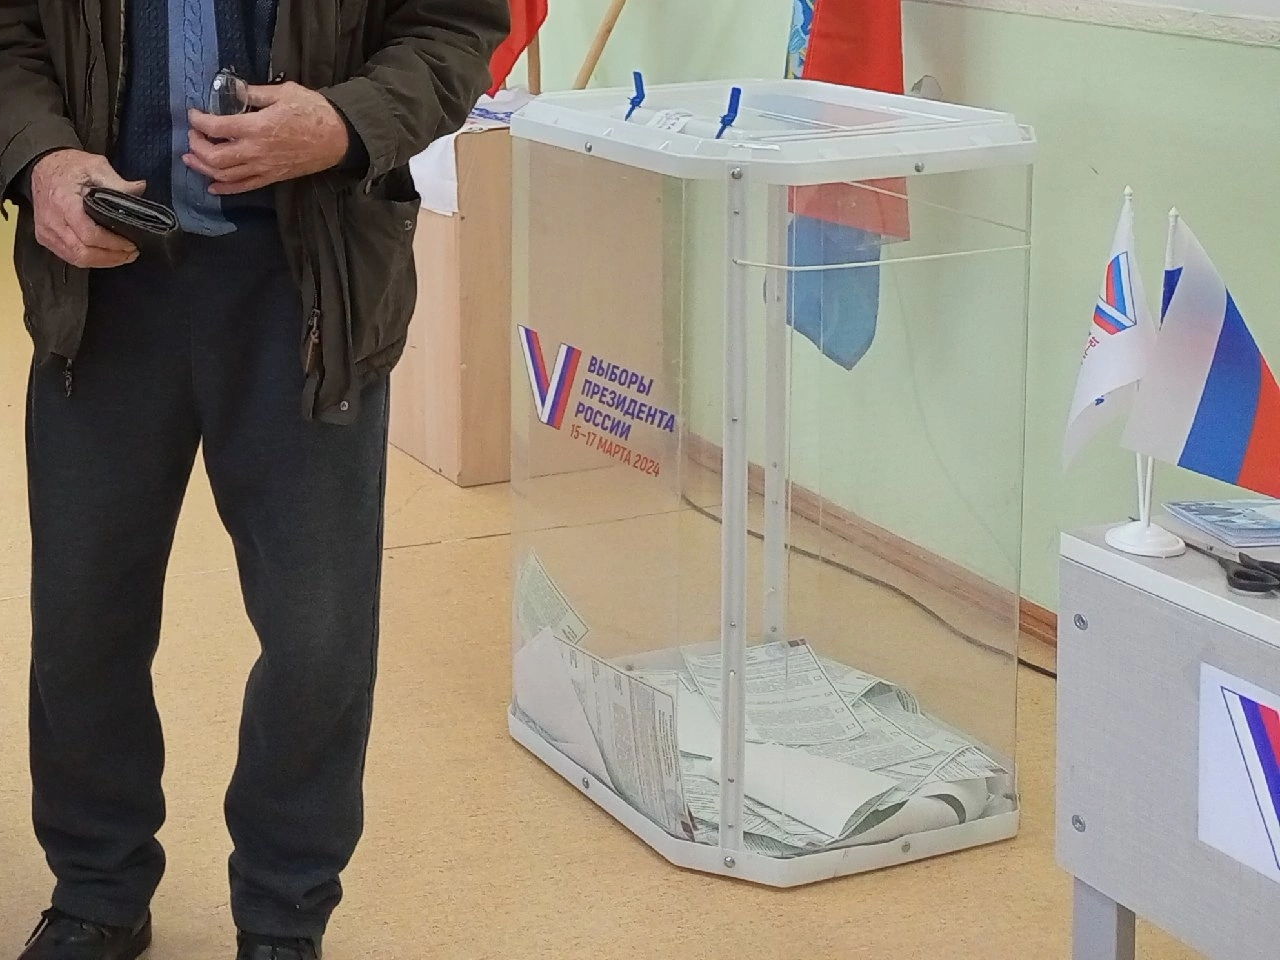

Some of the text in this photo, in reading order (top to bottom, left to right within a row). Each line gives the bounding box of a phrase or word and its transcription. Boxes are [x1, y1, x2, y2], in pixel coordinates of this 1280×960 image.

[587, 355, 654, 396] ВЫБОРЫ
[574, 401, 632, 441] РОССИИ
[581, 378, 676, 433] ПРЕЗИДЕНТА
[596, 435, 631, 466] МАРТА
[633, 453, 661, 478] 2024
